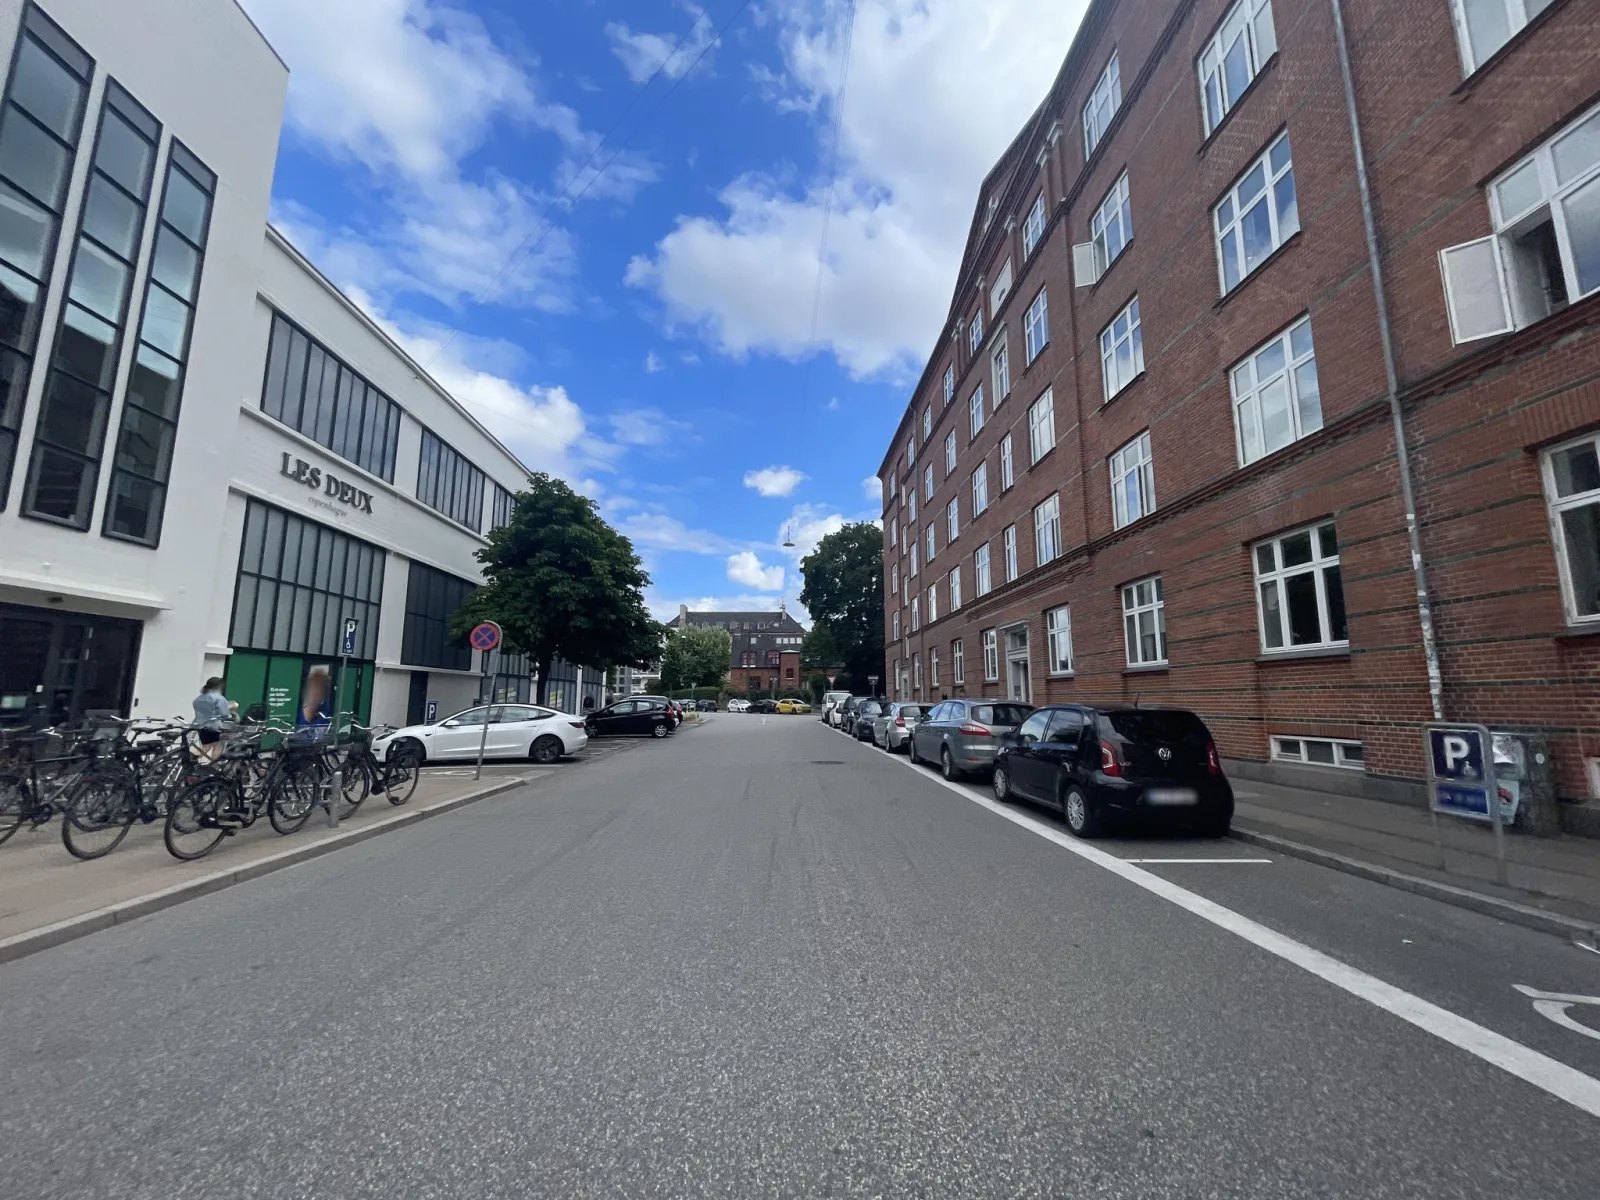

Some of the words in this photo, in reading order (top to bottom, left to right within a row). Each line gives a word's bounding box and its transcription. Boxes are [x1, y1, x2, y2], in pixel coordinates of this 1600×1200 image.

[280, 452, 321, 489] LES
[324, 474, 374, 514] DEUX
[346, 620, 356, 638] P
[429, 704, 435, 719] P
[1443, 736, 1469, 770] P
